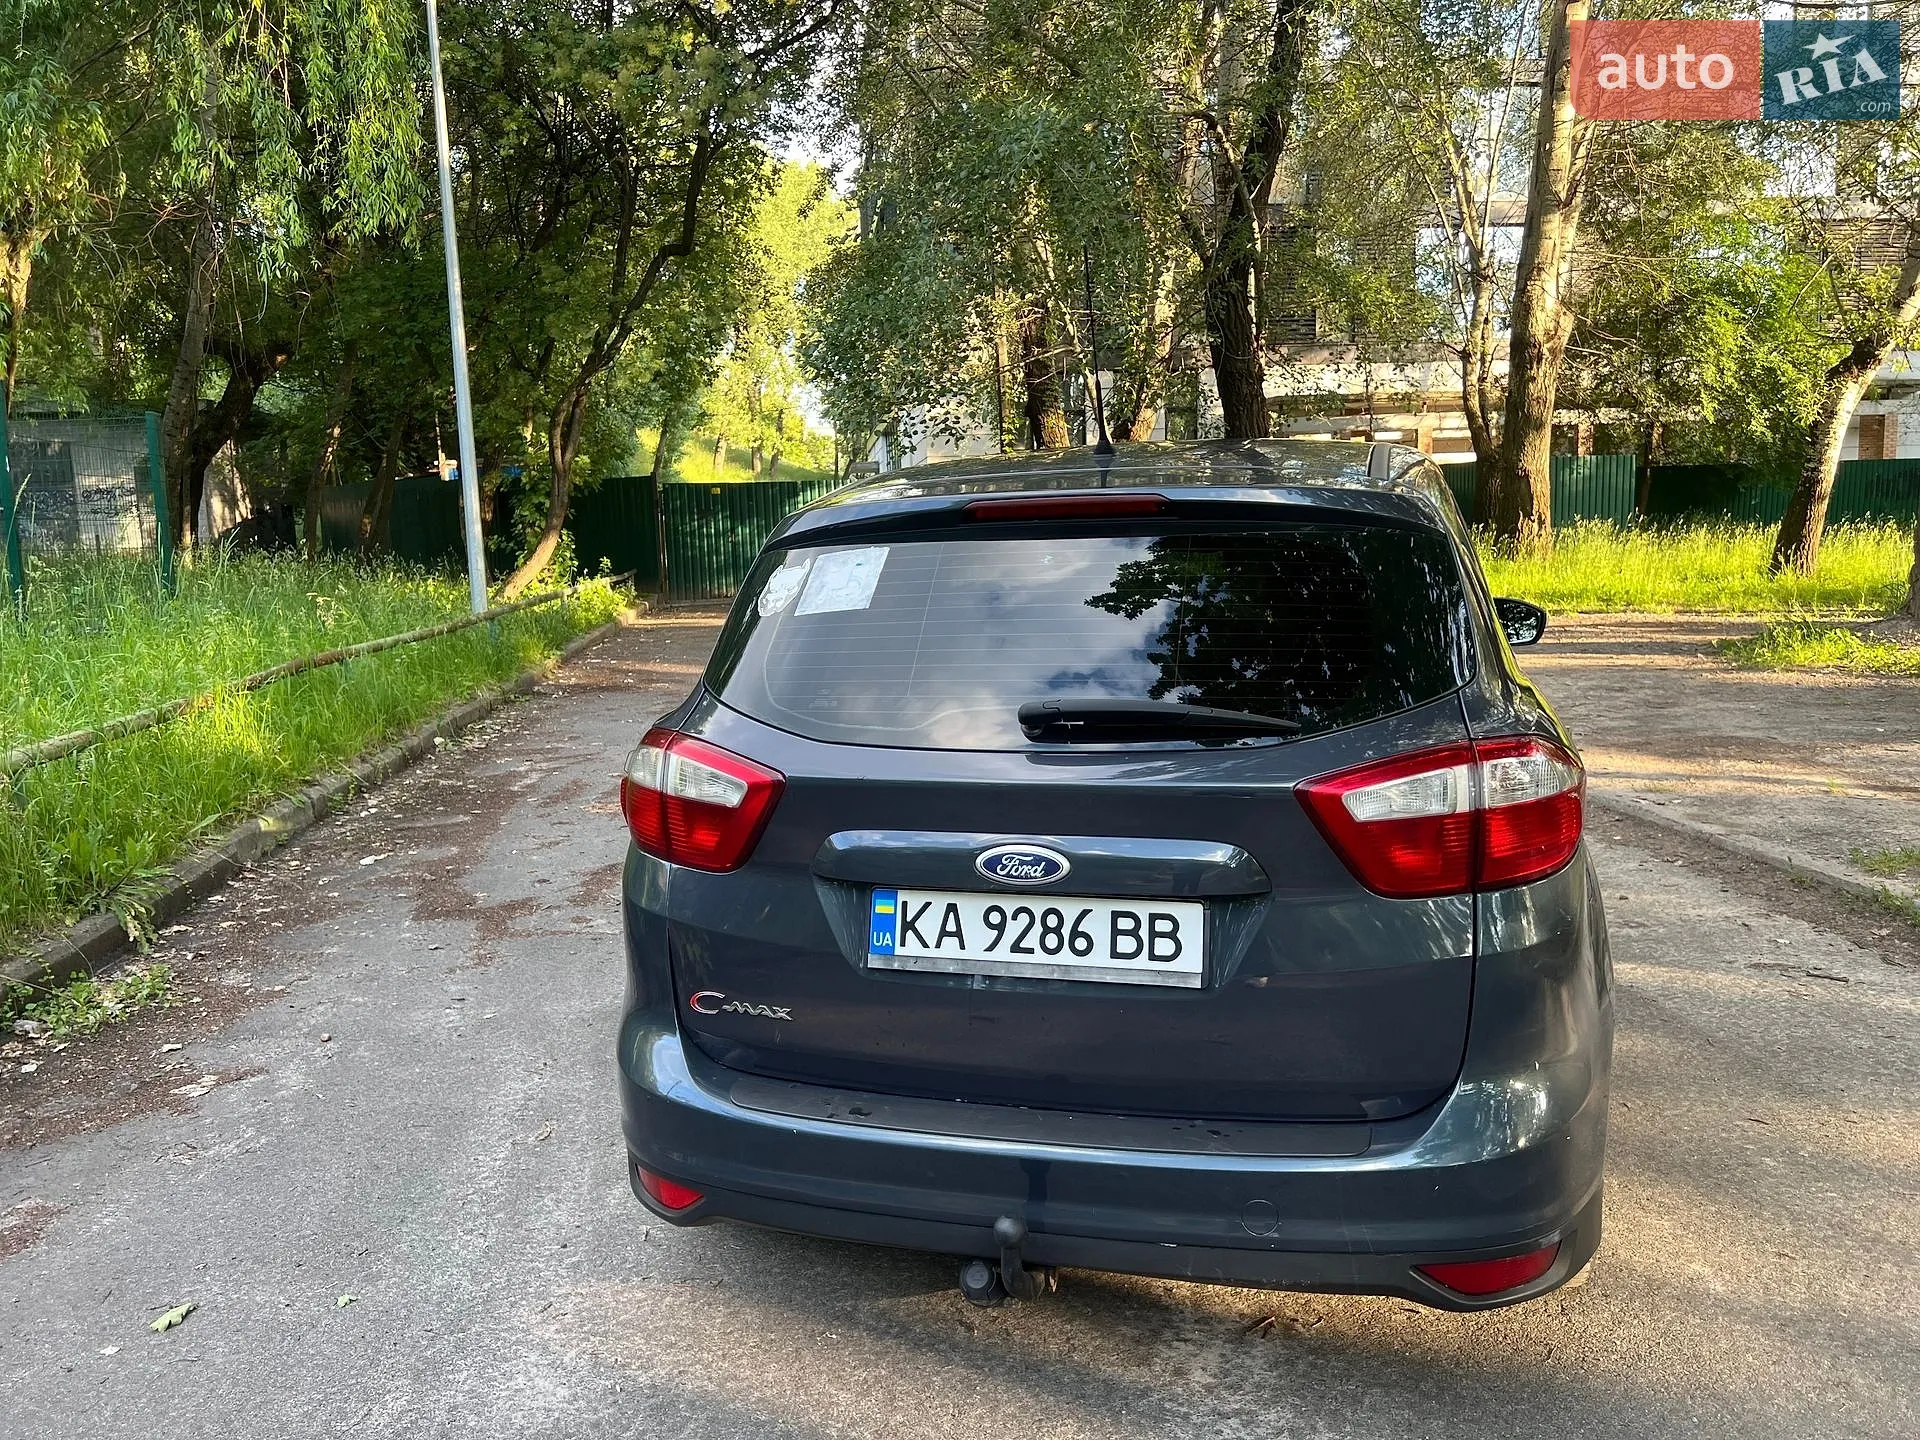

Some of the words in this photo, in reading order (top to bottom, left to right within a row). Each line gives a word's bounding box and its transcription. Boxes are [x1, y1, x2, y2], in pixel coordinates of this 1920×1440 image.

[996, 854, 1046, 878] Ford
[873, 931, 893, 947] UA
[900, 900, 966, 951] KA
[982, 904, 1094, 957] 9286
[1109, 909, 1183, 963] BB
